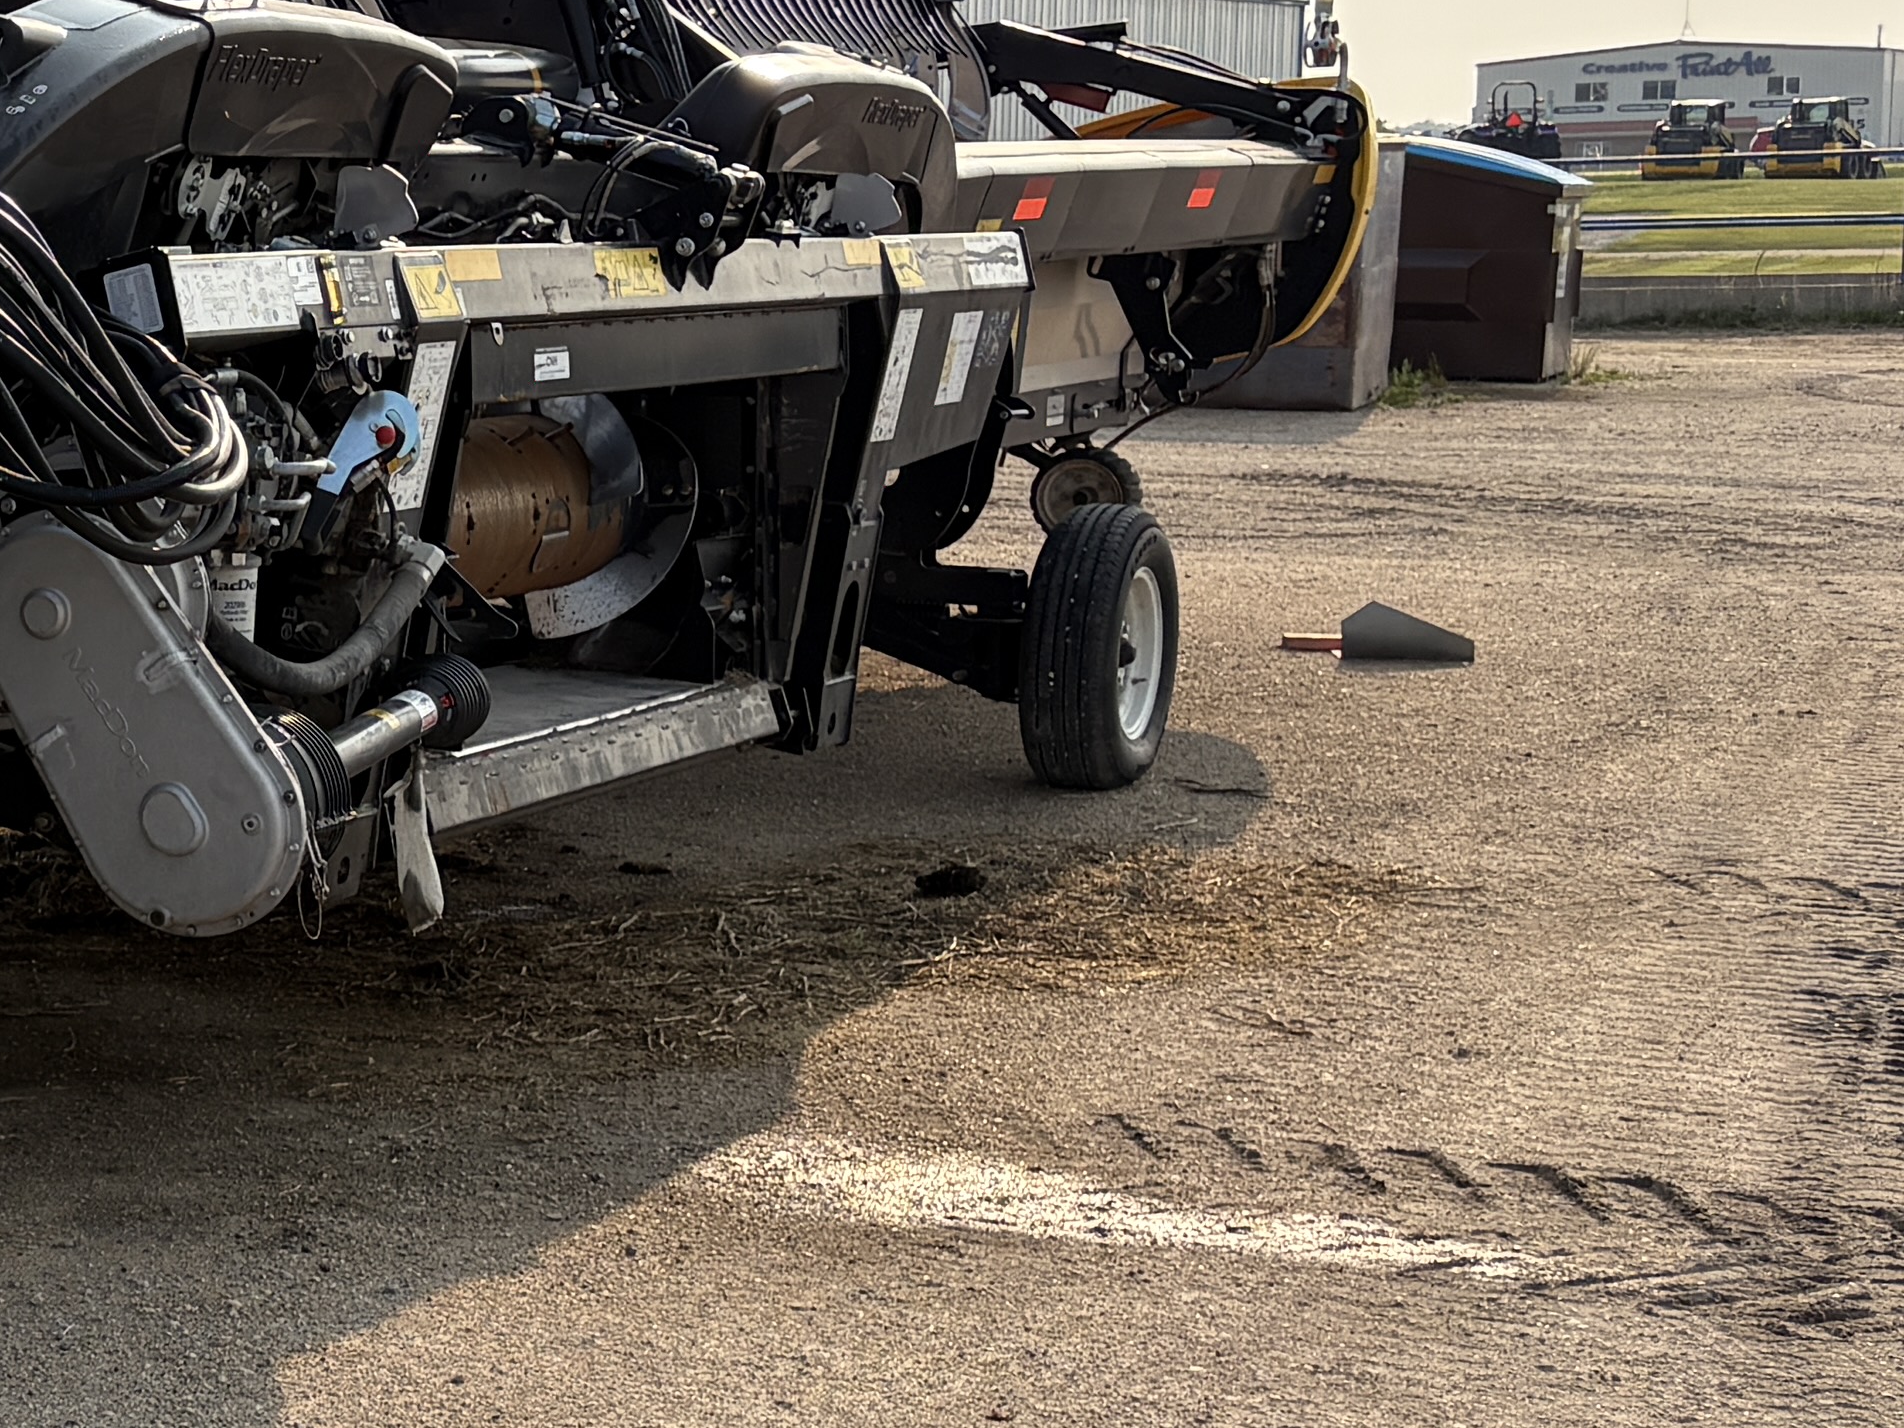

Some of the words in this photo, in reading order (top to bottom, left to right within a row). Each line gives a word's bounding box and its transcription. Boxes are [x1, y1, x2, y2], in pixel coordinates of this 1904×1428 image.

[206, 44, 317, 92] FlexDraper
[1582, 60, 1669, 75] Creative
[61, 646, 151, 779] MacDon
